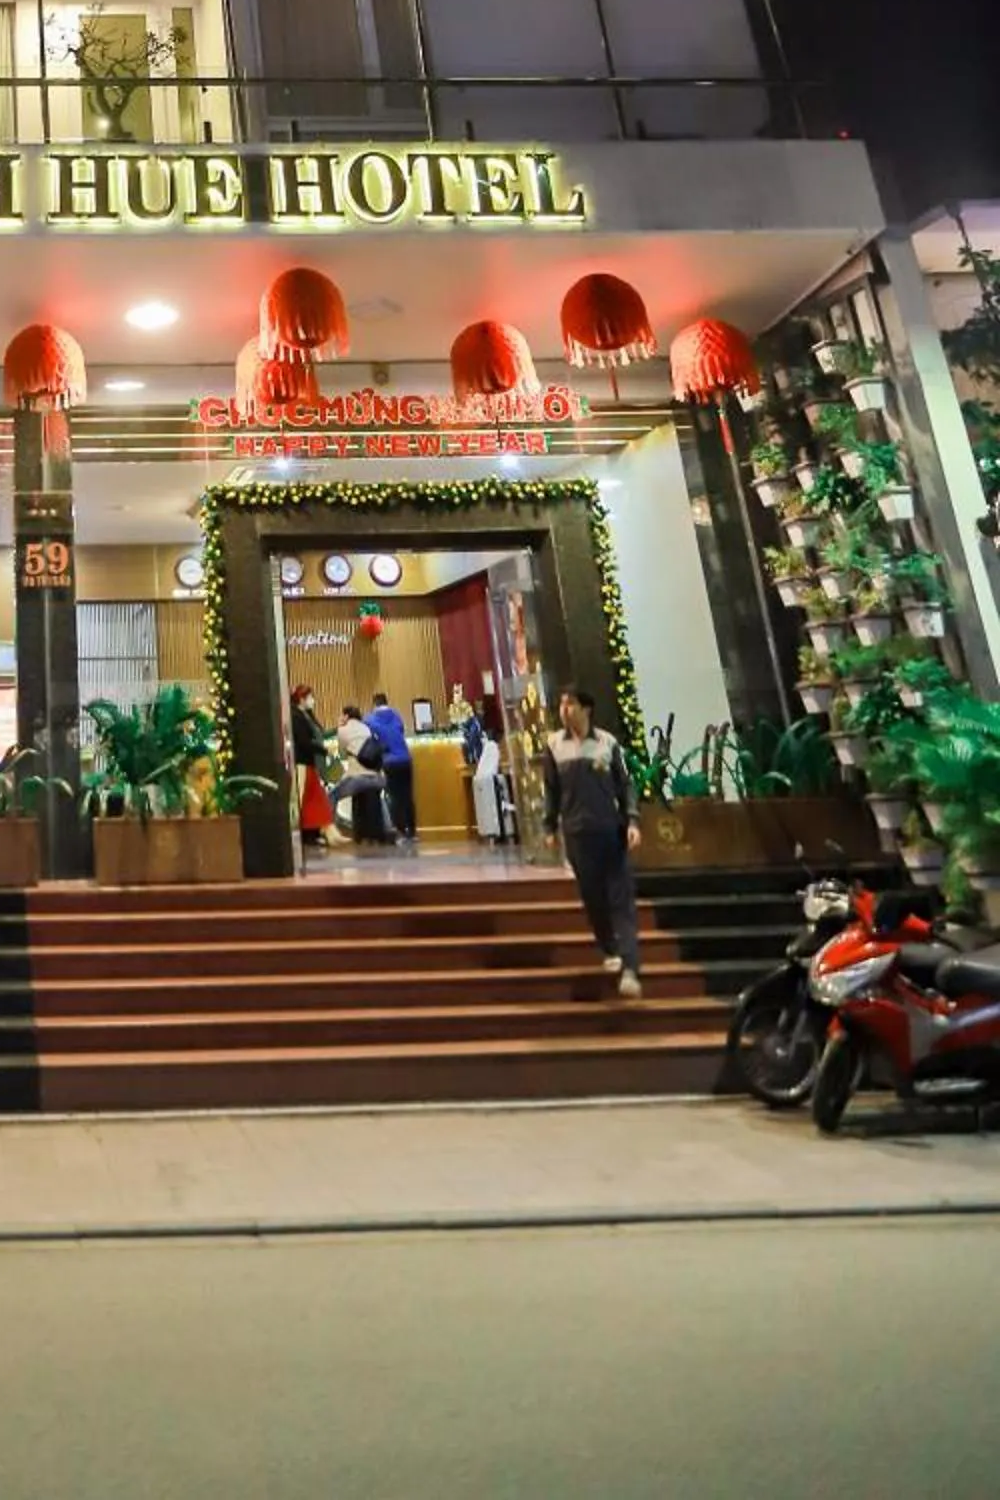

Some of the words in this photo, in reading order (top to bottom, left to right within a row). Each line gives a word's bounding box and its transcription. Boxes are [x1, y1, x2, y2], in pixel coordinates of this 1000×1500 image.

[46, 150, 244, 223] HUE
[270, 150, 586, 223] HOTEL
[234, 436, 350, 457] HAPPY
[364, 434, 441, 456] NEW
[456, 432, 547, 454] YEAR
[25, 542, 69, 575] 59
